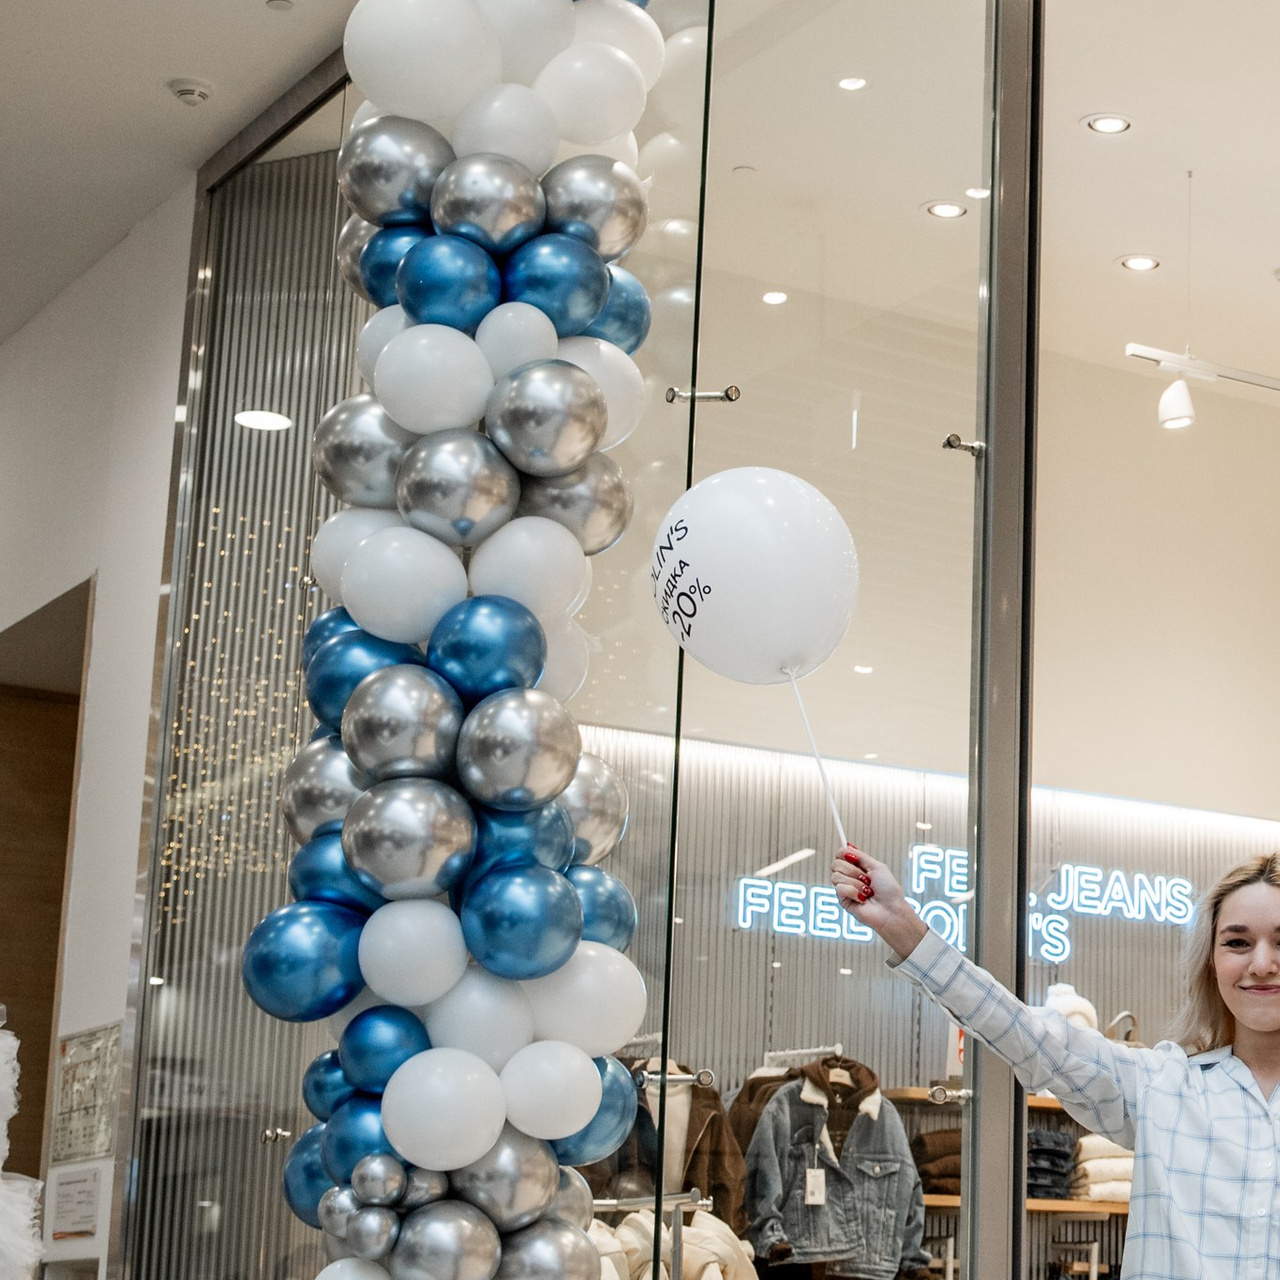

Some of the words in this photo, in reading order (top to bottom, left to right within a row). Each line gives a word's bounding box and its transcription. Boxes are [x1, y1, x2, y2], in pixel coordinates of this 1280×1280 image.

[661, 559, 690, 625] СКИДКА
[672, 577, 712, 642] -20%
[1046, 863, 1194, 925] JEANS
